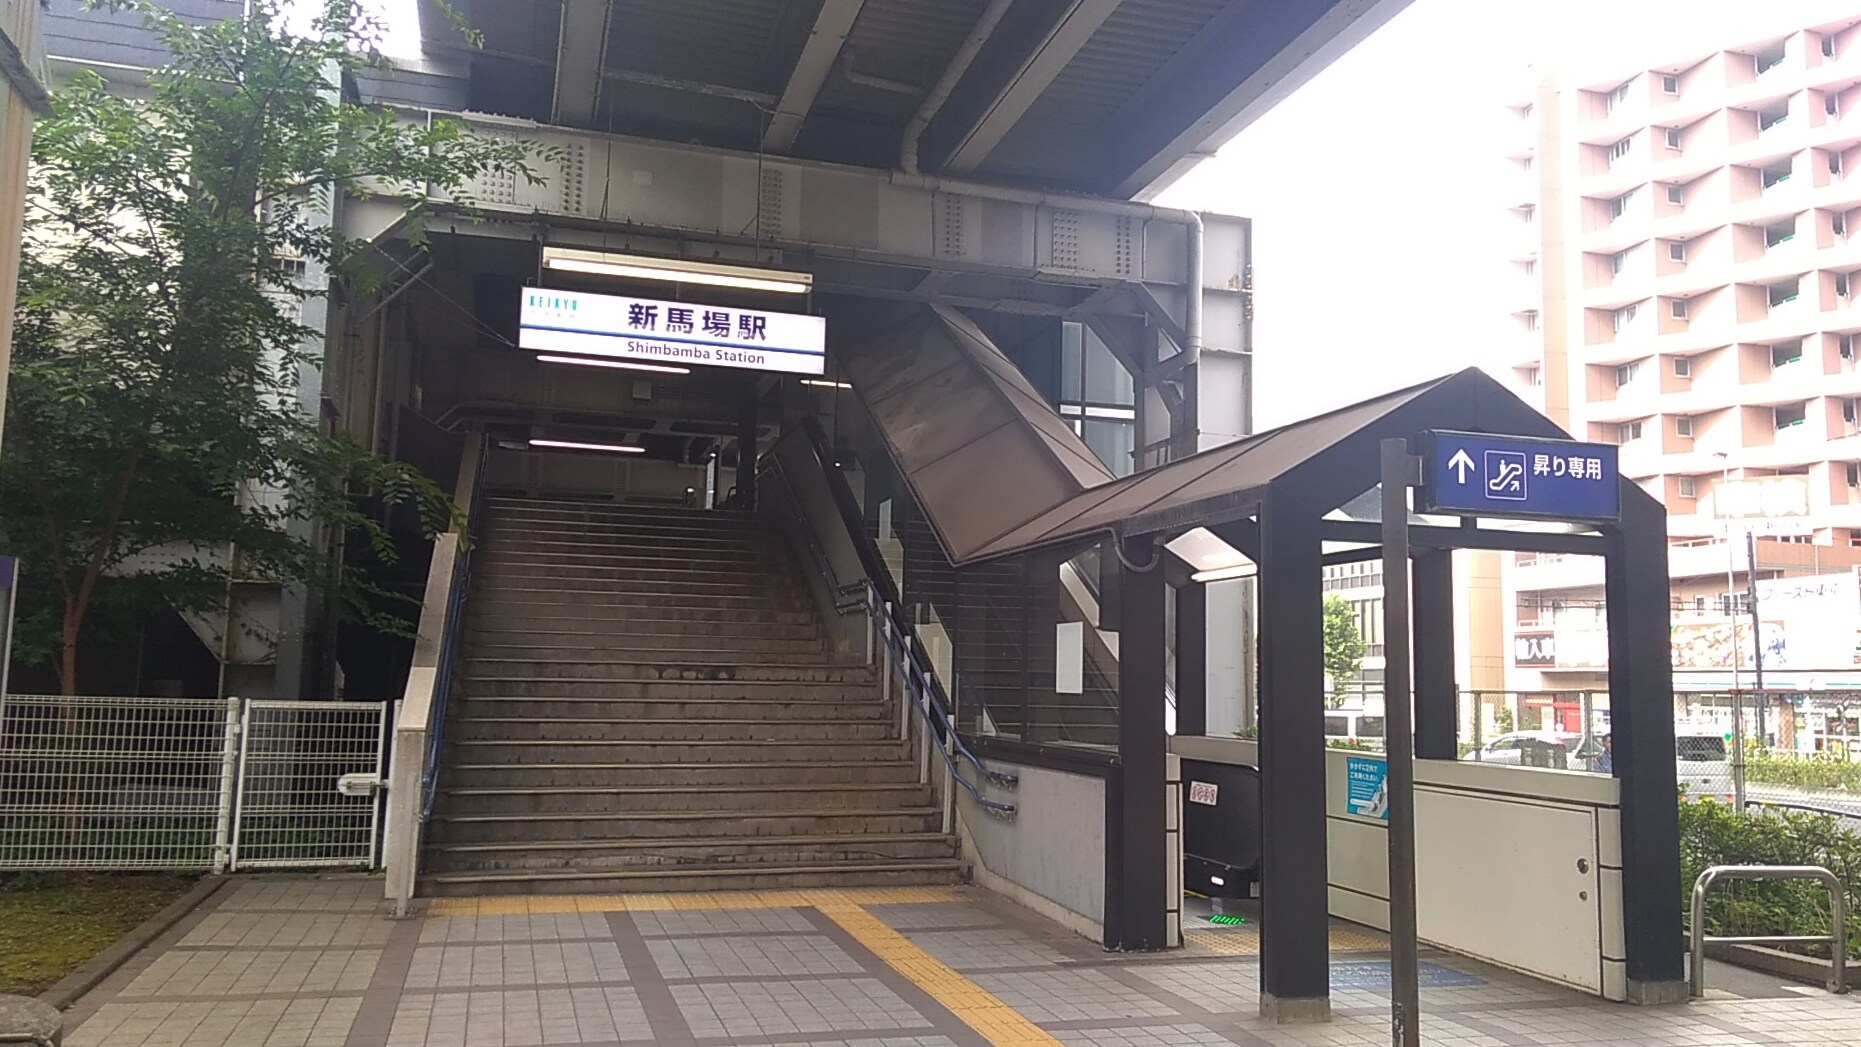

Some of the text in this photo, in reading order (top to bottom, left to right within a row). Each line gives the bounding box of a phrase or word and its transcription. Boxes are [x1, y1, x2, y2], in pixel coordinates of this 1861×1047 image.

[529, 295, 578, 311] KEIKYU
[628, 303, 767, 341] 新馬場駅
[627, 341, 766, 365] Shimbamba Station
[1533, 454, 1602, 480] 昇り専用
